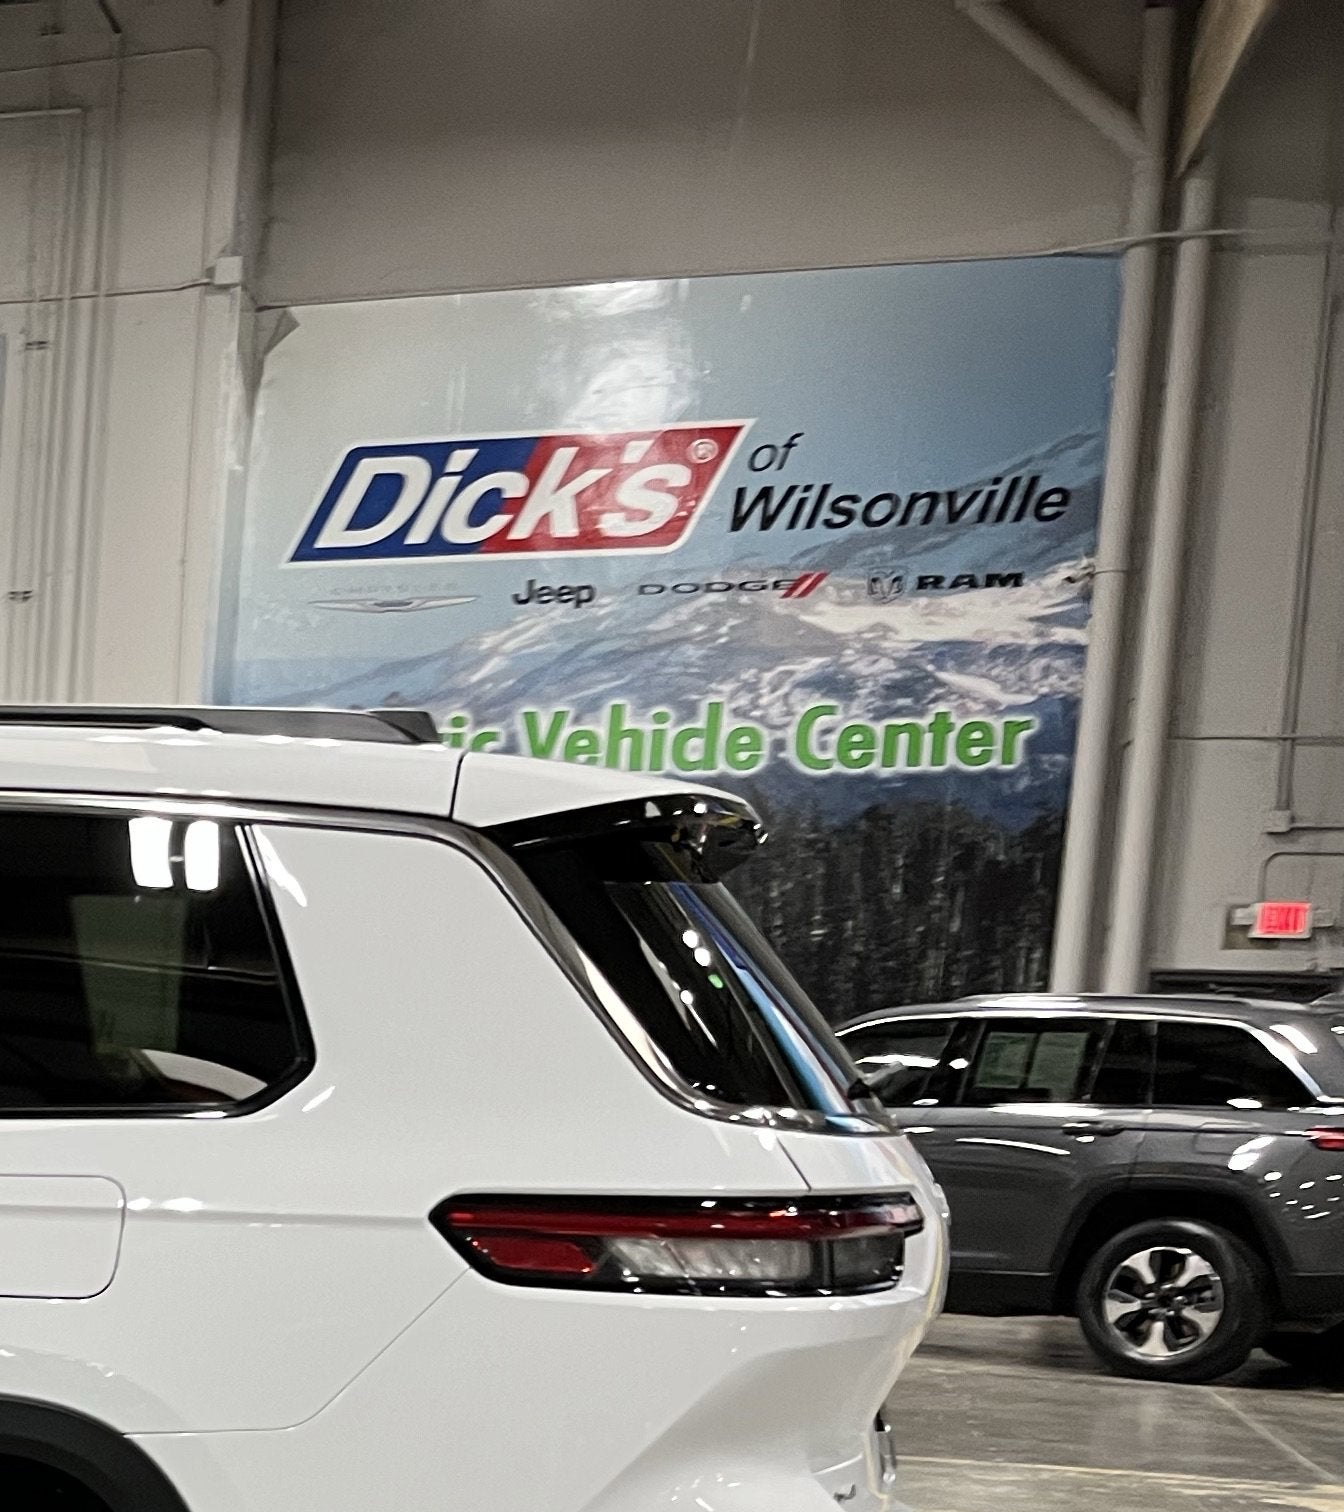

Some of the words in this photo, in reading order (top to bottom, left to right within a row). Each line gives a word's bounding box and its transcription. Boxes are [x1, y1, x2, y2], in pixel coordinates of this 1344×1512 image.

[313, 440, 693, 550] Dick's
[748, 432, 805, 472] of
[727, 474, 1072, 533] Wilsonville
[513, 578, 596, 609] Jeep
[637, 576, 796, 597] DODGE
[916, 570, 1025, 591] RAM
[522, 701, 762, 772] Vehicle
[795, 704, 1034, 770] Center
